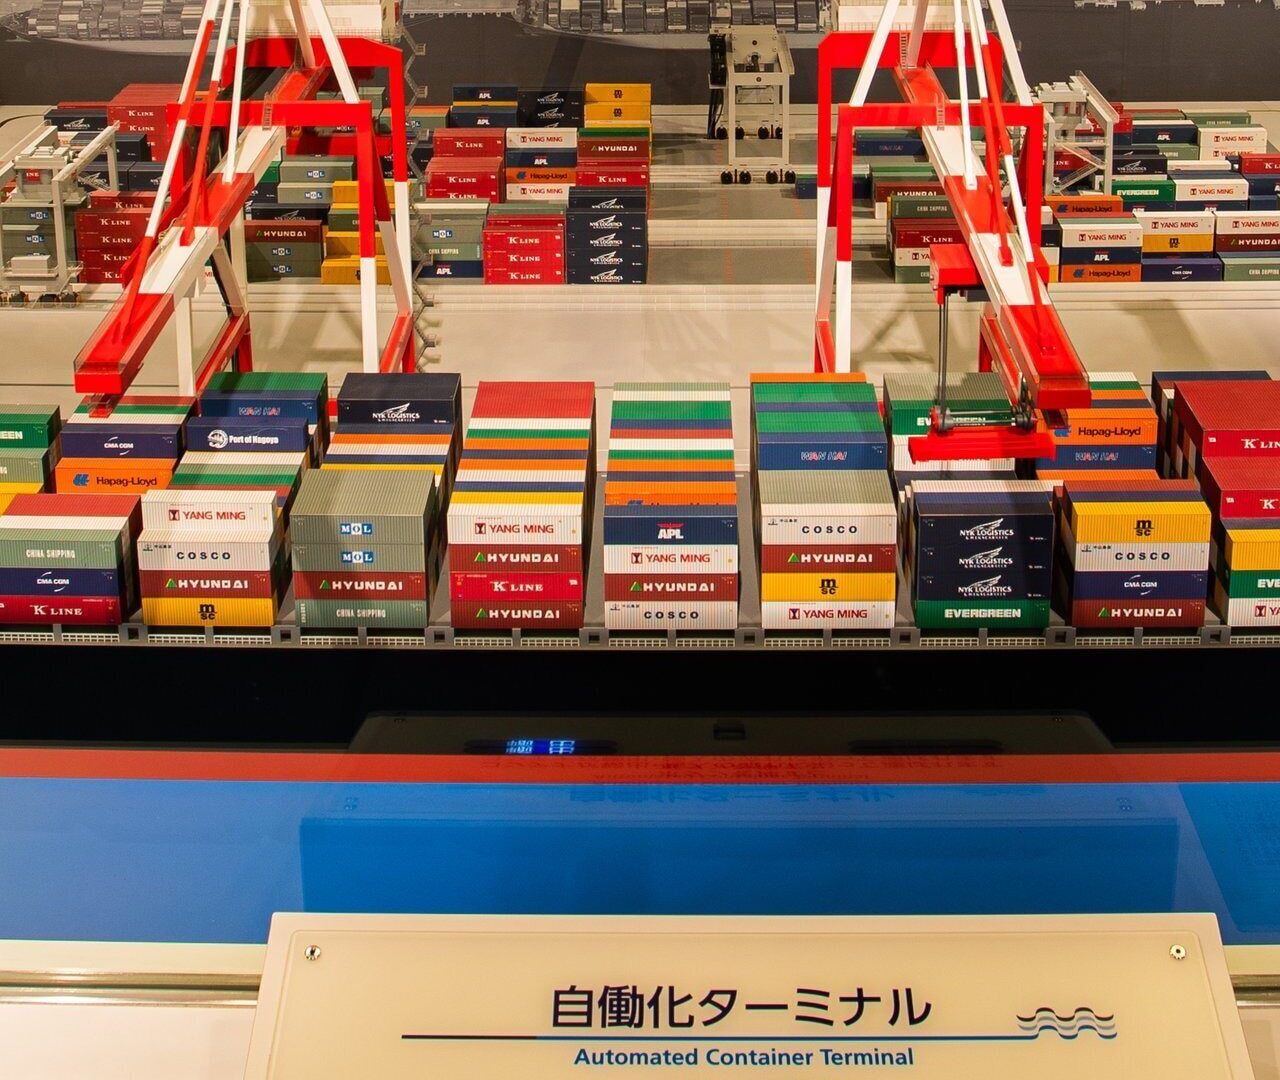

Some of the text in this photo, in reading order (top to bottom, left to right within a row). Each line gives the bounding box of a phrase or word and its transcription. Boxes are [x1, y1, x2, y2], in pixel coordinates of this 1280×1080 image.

[530, 172, 567, 180] Hapag-Lloyd
[1078, 427, 1141, 437] Hapag-Lloyd
[228, 435, 279, 444] Port of Nagoya
[182, 511, 245, 520] YANG MING
[341, 524, 372, 535] MOL
[489, 524, 553, 533] YANG MING
[801, 525, 857, 533] COSCO
[657, 528, 684, 539] APL
[176, 551, 230, 559] COSCO
[1114, 552, 1170, 560] COSCO
[178, 579, 248, 588] HYUNDAI
[332, 581, 402, 590] HYUNDAI
[510, 583, 543, 591] LINE
[643, 582, 714, 591] HYUNDAI
[1111, 608, 1182, 617] HYUNDAI
[552, 985, 931, 1028] 自働化ターミナル
[573, 1047, 913, 1065] Automated Container Terminal
